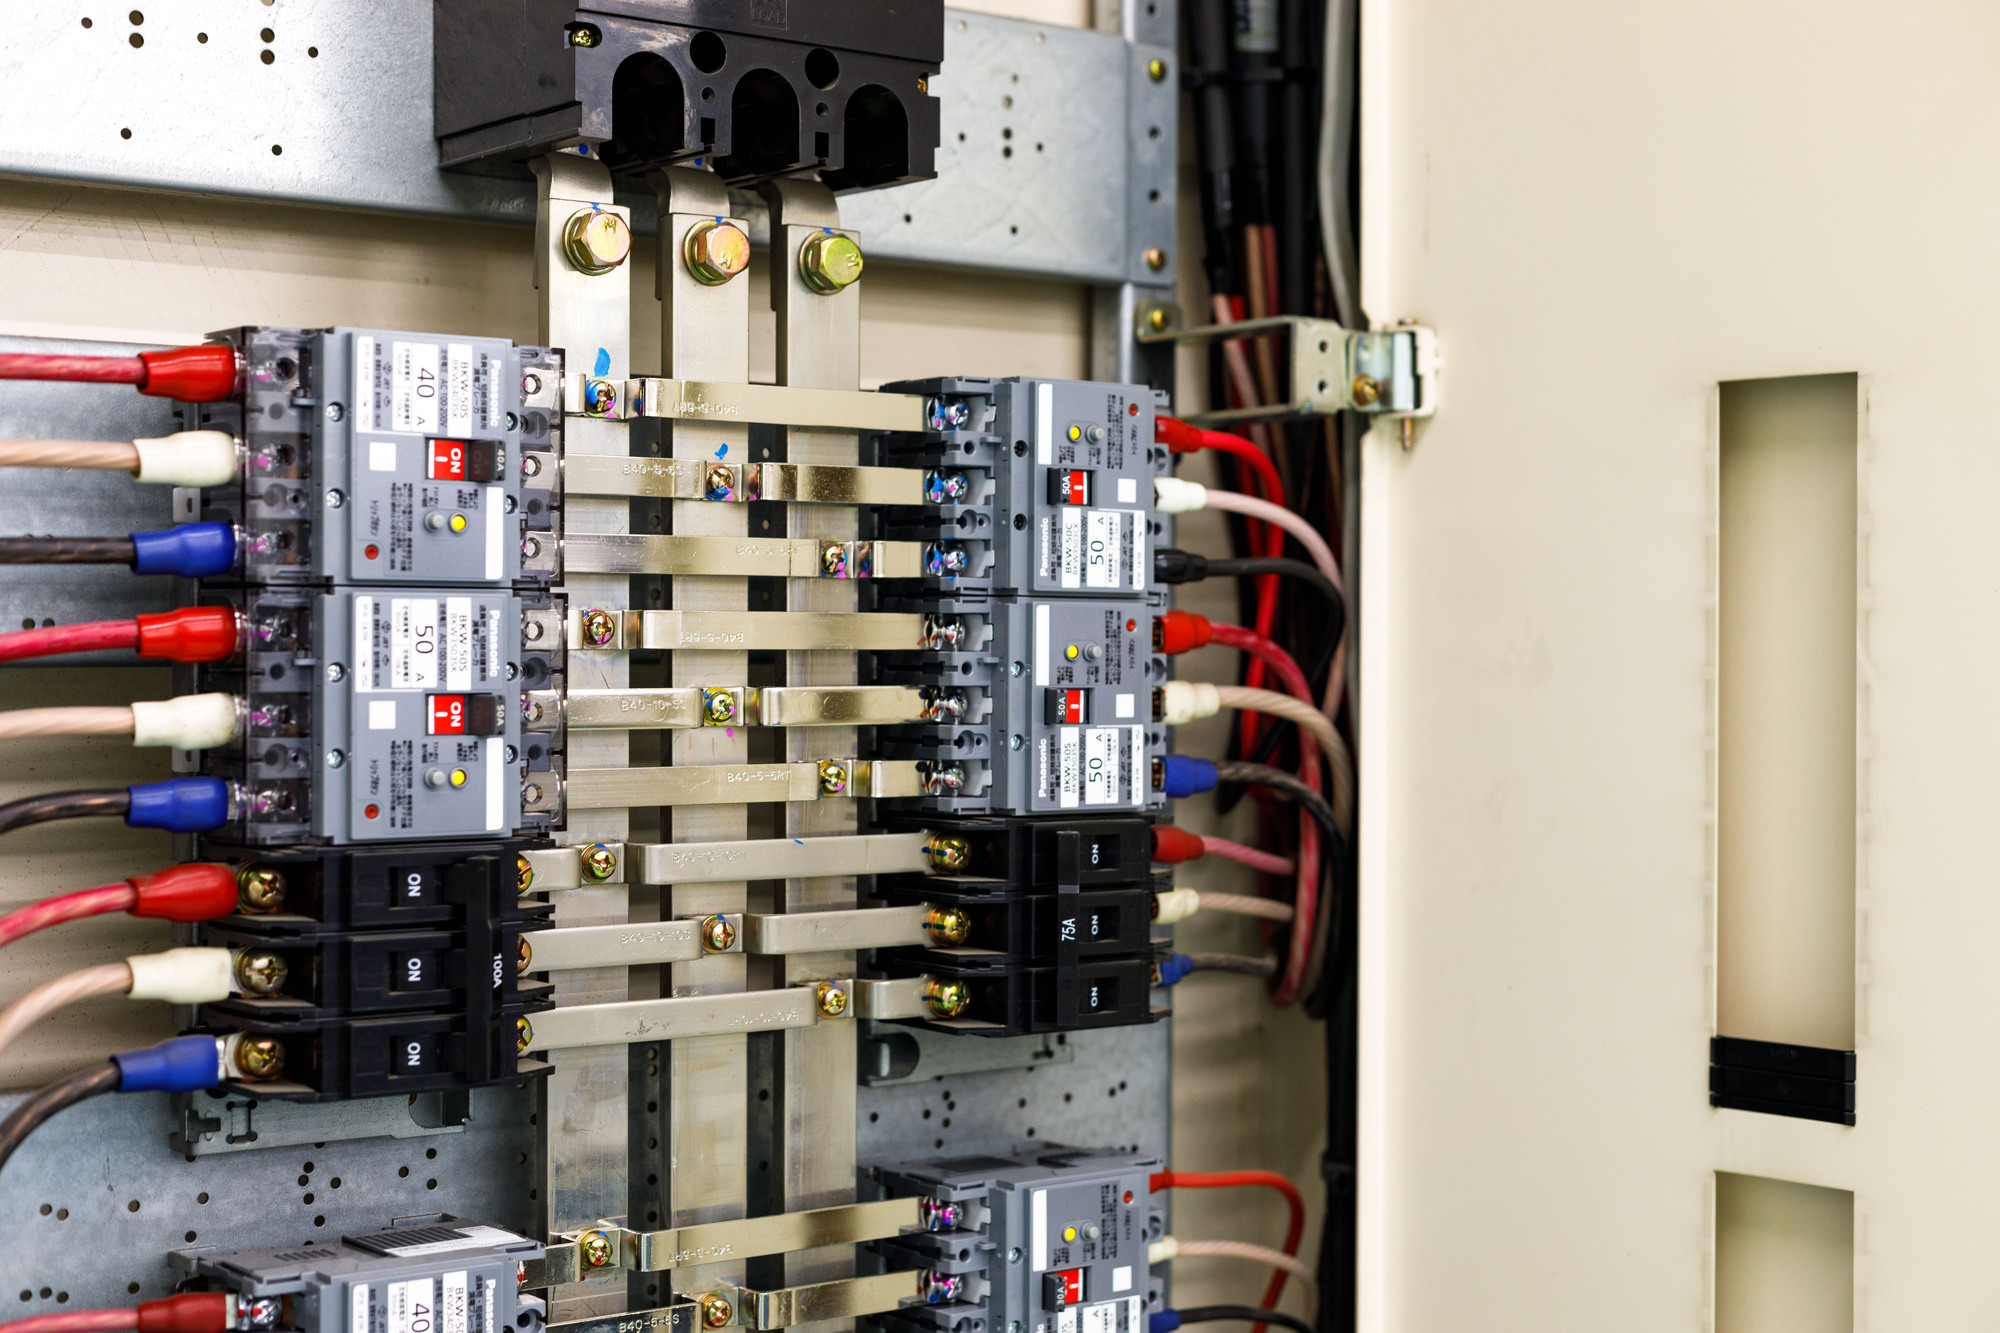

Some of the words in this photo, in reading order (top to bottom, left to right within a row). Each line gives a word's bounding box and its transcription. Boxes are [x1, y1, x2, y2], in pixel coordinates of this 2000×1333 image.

[417, 368, 435, 399] 40
[440, 378, 448, 391] AC
[460, 362, 469, 418] BKW-50S
[490, 360, 501, 427] Panasonic
[416, 416, 426, 426] A
[450, 447, 462, 474] ON
[496, 449, 505, 472] 40A
[1062, 475, 1071, 495] 50A
[1097, 516, 1104, 525] A
[1039, 518, 1049, 577] Panasonic
[1064, 523, 1073, 574] BKW-50C
[1081, 547, 1087, 557] AC
[1090, 540, 1105, 565] 50
[415, 625, 434, 654] 50
[439, 633, 447, 643] AC
[459, 615, 468, 672] BKW-50S
[489, 610, 501, 677] Panasonic
[416, 672, 425, 682] A
[439, 647, 447, 682] 100-200V
[450, 701, 462, 728] ON
[496, 704, 505, 726] 50A
[1057, 696, 1066, 716] 50A
[1095, 733, 1103, 742] A
[1038, 738, 1047, 798] Panasonic
[1063, 743, 1071, 792] BKW-50S
[1079, 766, 1085, 776] AC
[1088, 757, 1103, 782] 50
[1091, 844, 1099, 864] ON
[407, 873, 421, 897] ON
[1061, 917, 1076, 942] 75A
[1091, 914, 1098, 935] ON
[407, 957, 421, 982] ON
[492, 952, 503, 989] 100A
[1090, 986, 1098, 1007] ON
[407, 1042, 421, 1066] ON
[1056, 1286, 1065, 1306] 30A
[412, 1303, 430, 1333] 40
